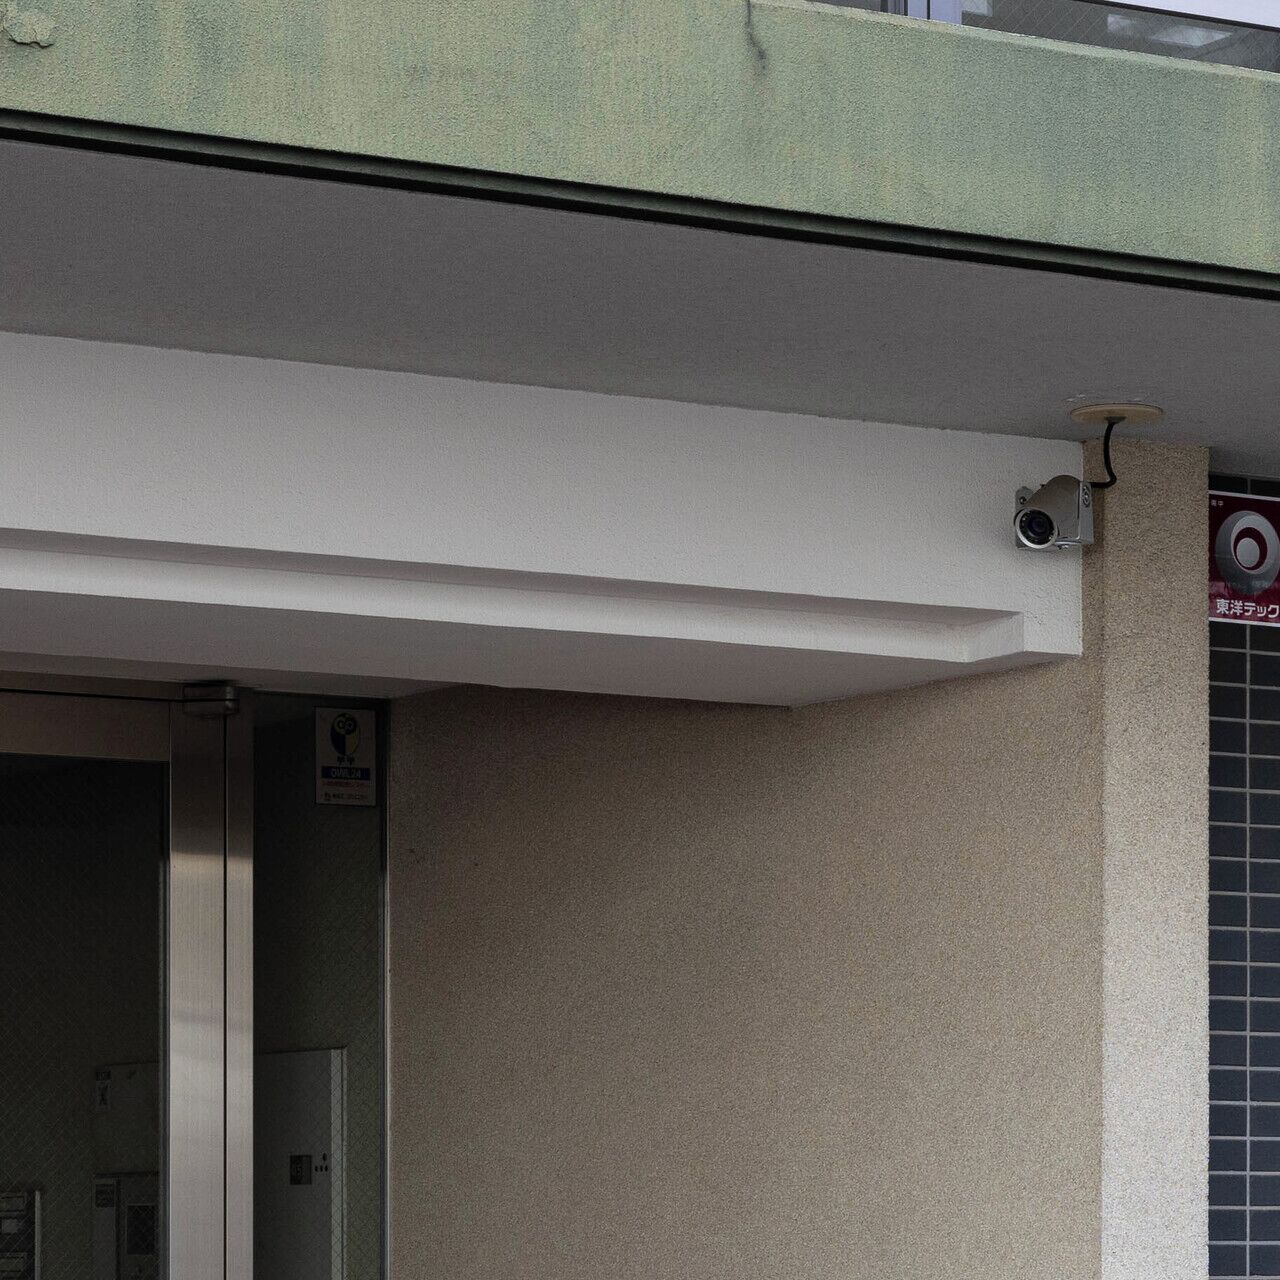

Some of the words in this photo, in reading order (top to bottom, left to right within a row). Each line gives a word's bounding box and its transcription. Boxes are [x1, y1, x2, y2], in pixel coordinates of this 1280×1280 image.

[1216, 599, 1280, 618] 東洋テック
